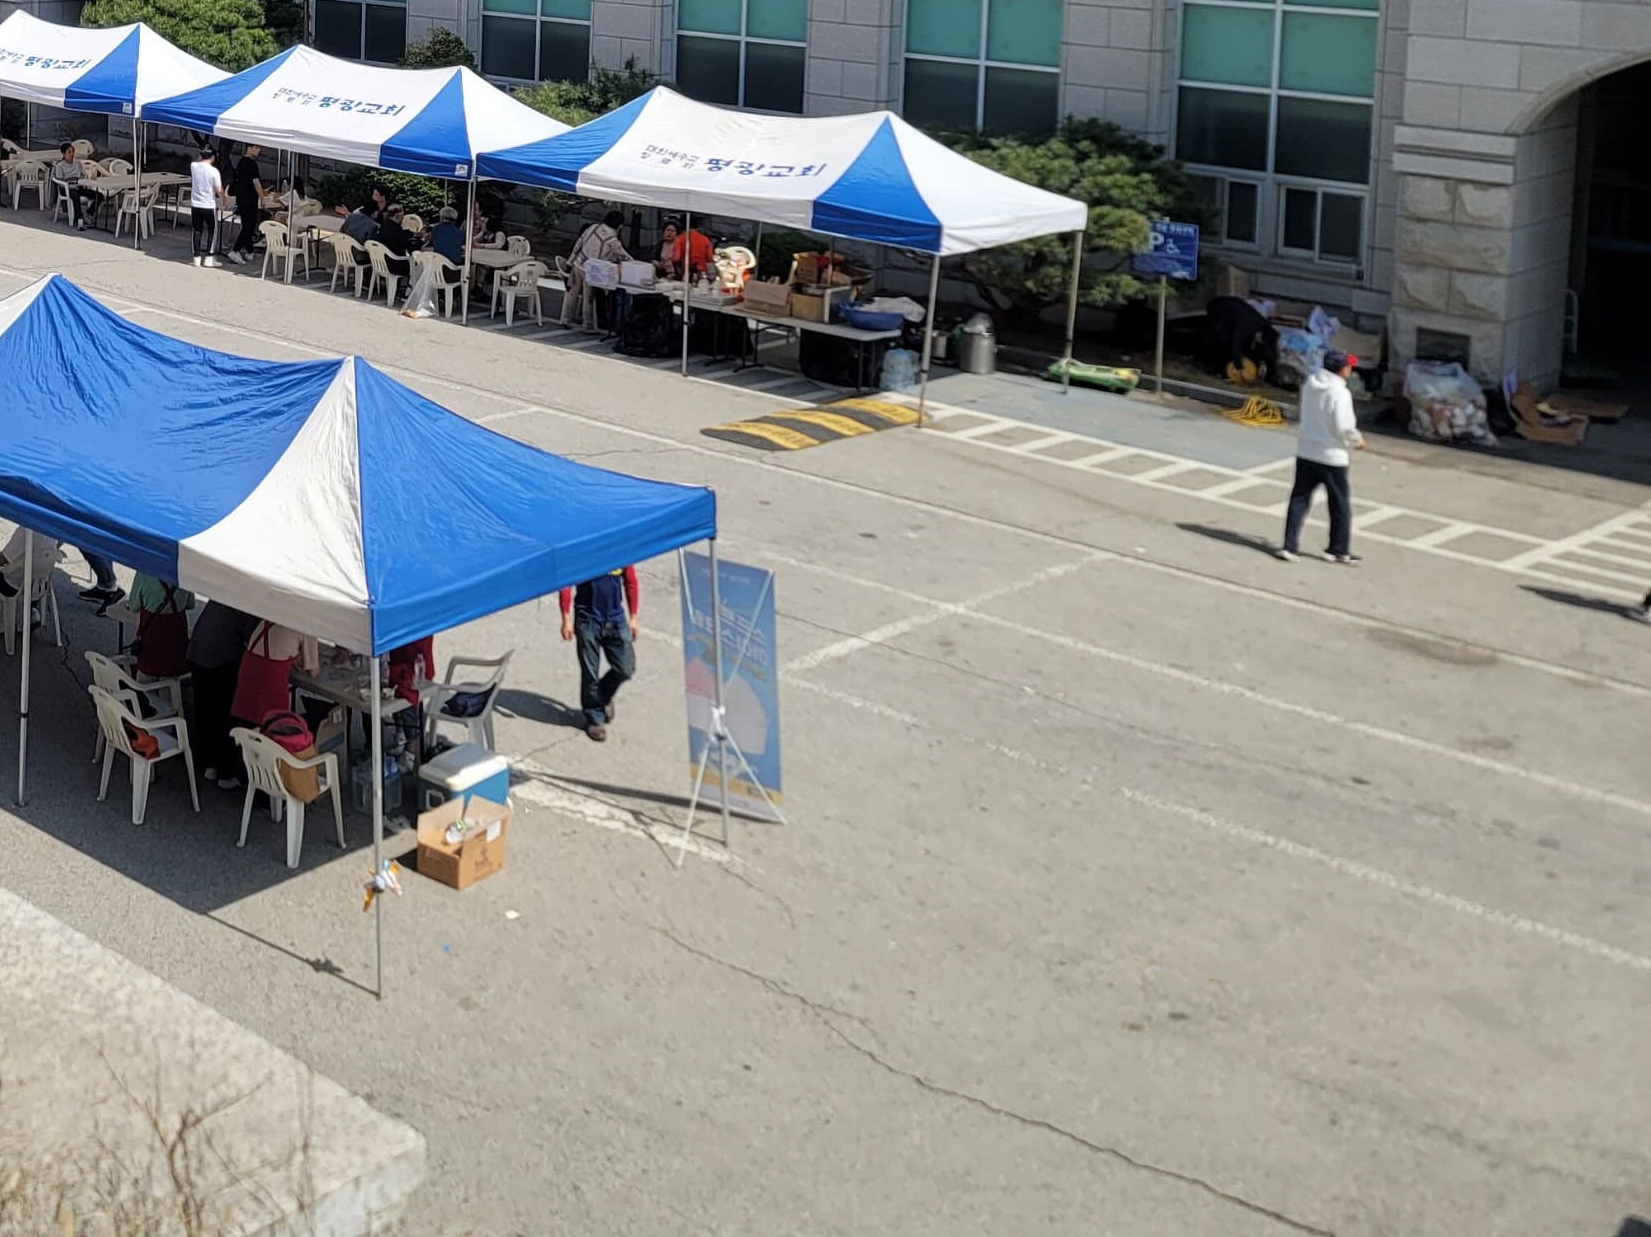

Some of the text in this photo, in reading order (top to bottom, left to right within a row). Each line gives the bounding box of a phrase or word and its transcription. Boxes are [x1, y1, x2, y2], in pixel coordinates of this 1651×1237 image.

[318, 96, 407, 117] 평광교회
[704, 158, 828, 177] 평광교회
[1149, 231, 1165, 251] P
